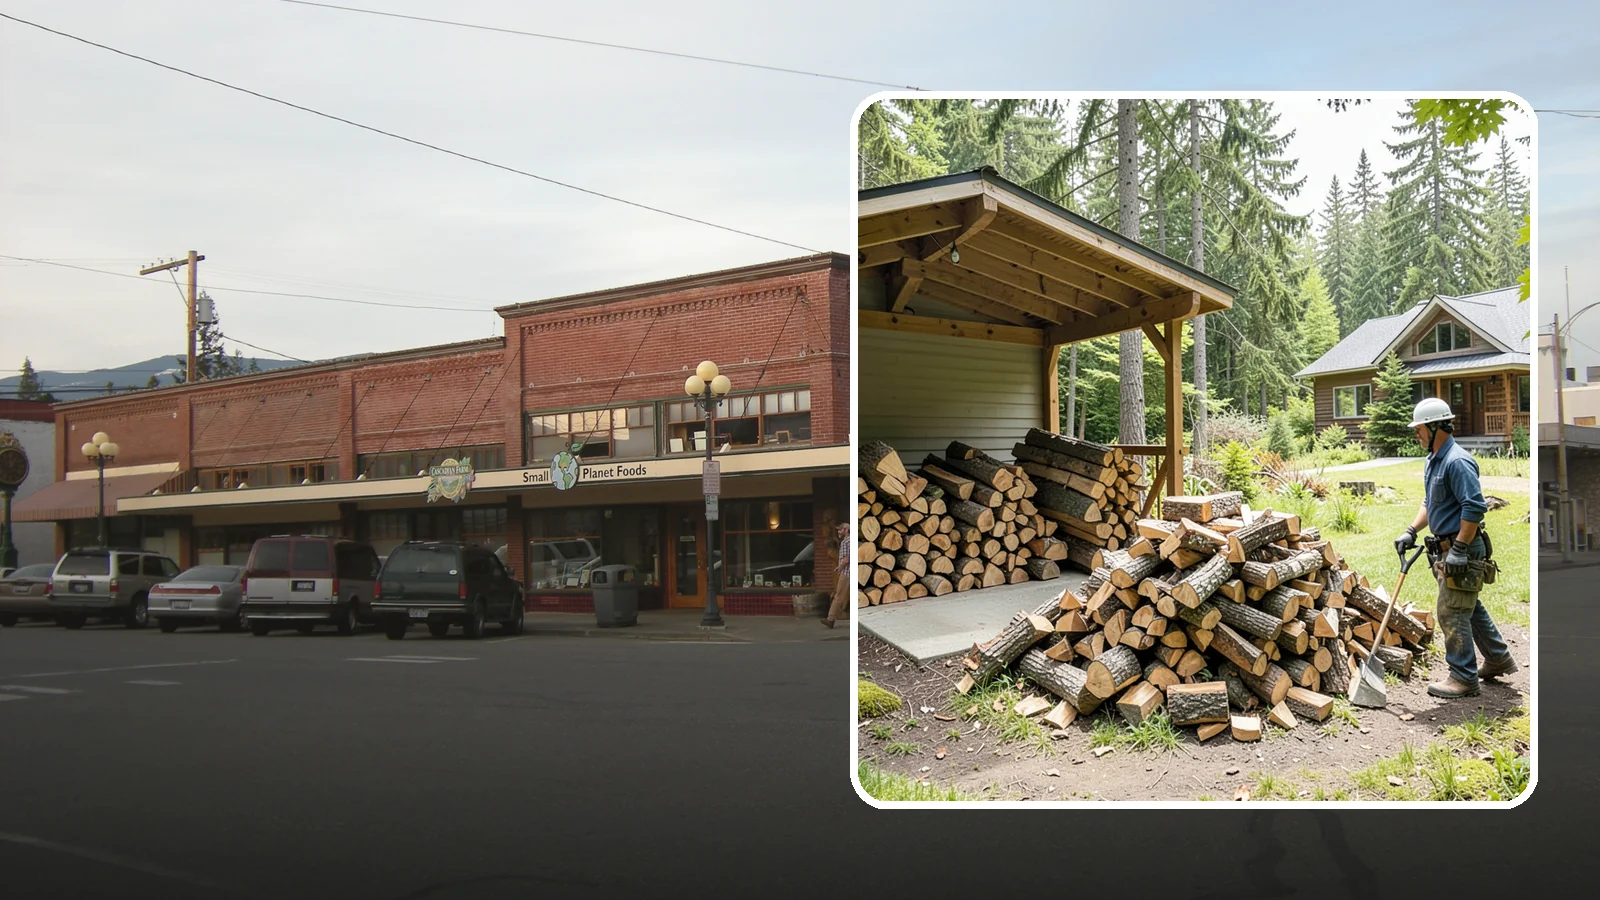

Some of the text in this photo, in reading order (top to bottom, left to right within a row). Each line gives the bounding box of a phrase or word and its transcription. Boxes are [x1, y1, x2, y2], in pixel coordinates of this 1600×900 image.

[523, 464, 647, 483] Small Planet Foods
